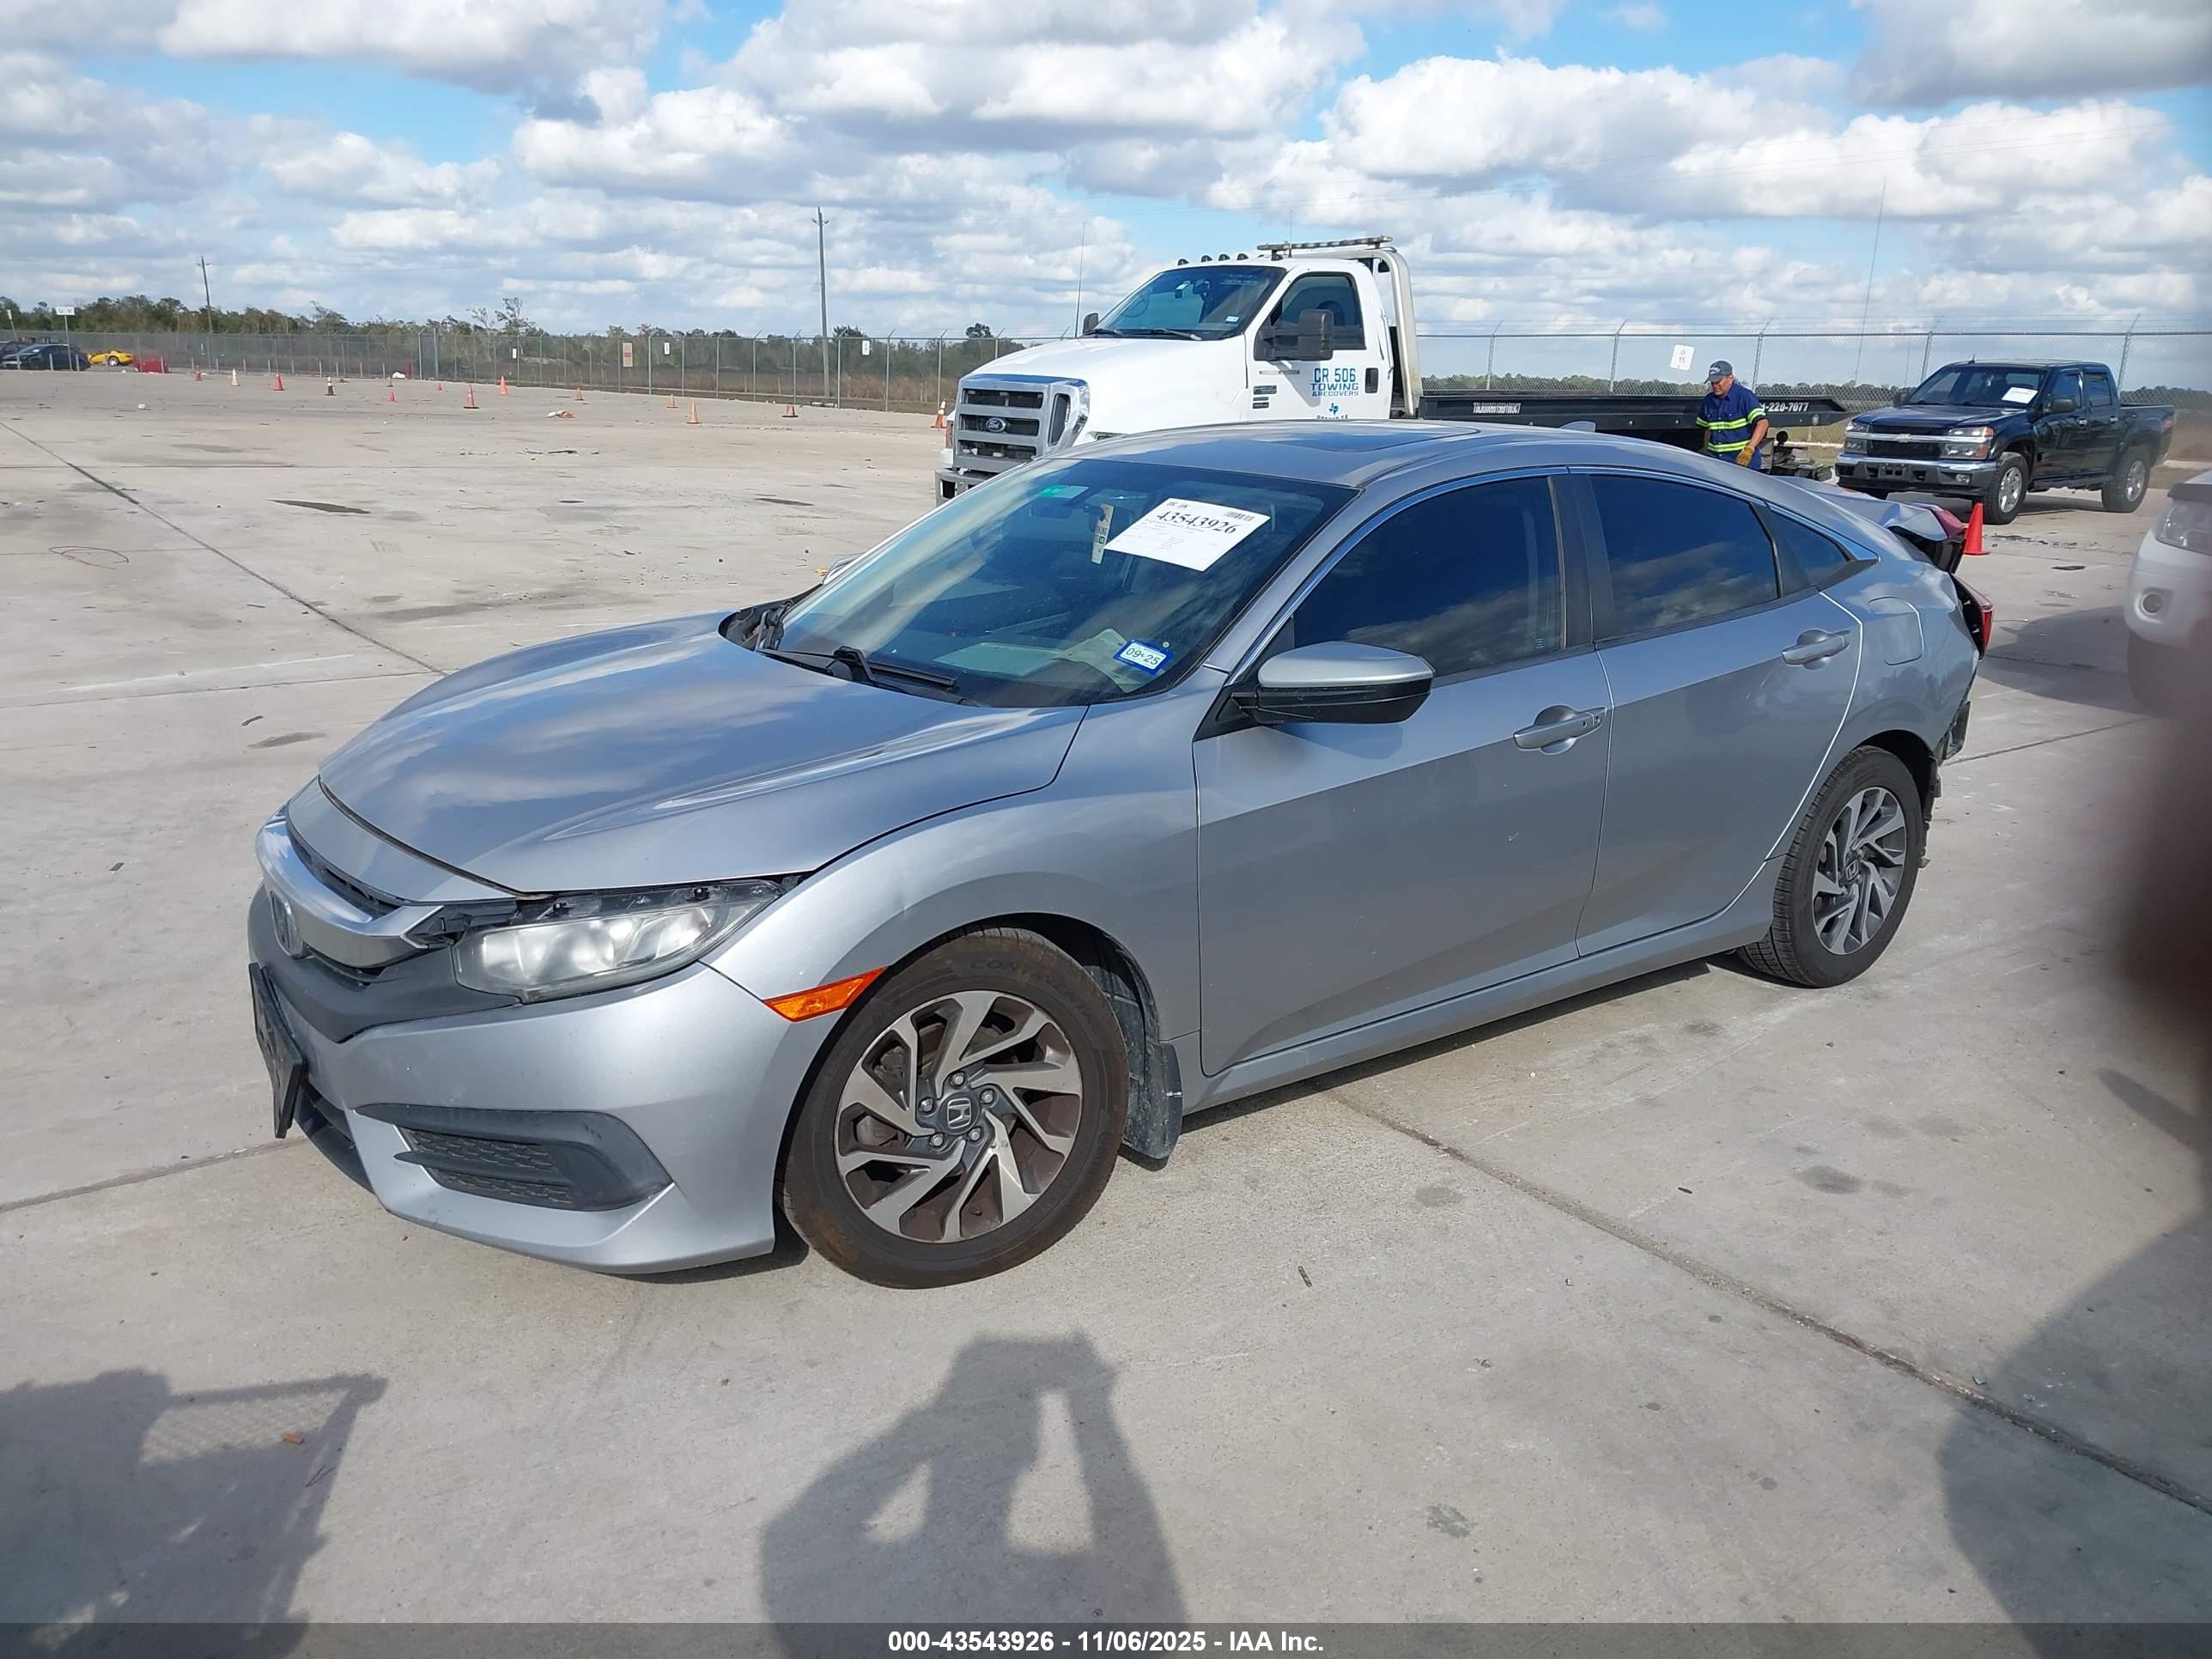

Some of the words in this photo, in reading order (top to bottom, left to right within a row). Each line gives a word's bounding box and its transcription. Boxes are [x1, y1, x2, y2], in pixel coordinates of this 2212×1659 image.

[1314, 368, 1329, 383] CR
[1334, 368, 1357, 383] 506
[1310, 382, 1359, 391] TOWING
[1759, 402, 1809, 412] 1-220-7077
[1156, 510, 1243, 535] 43543926
